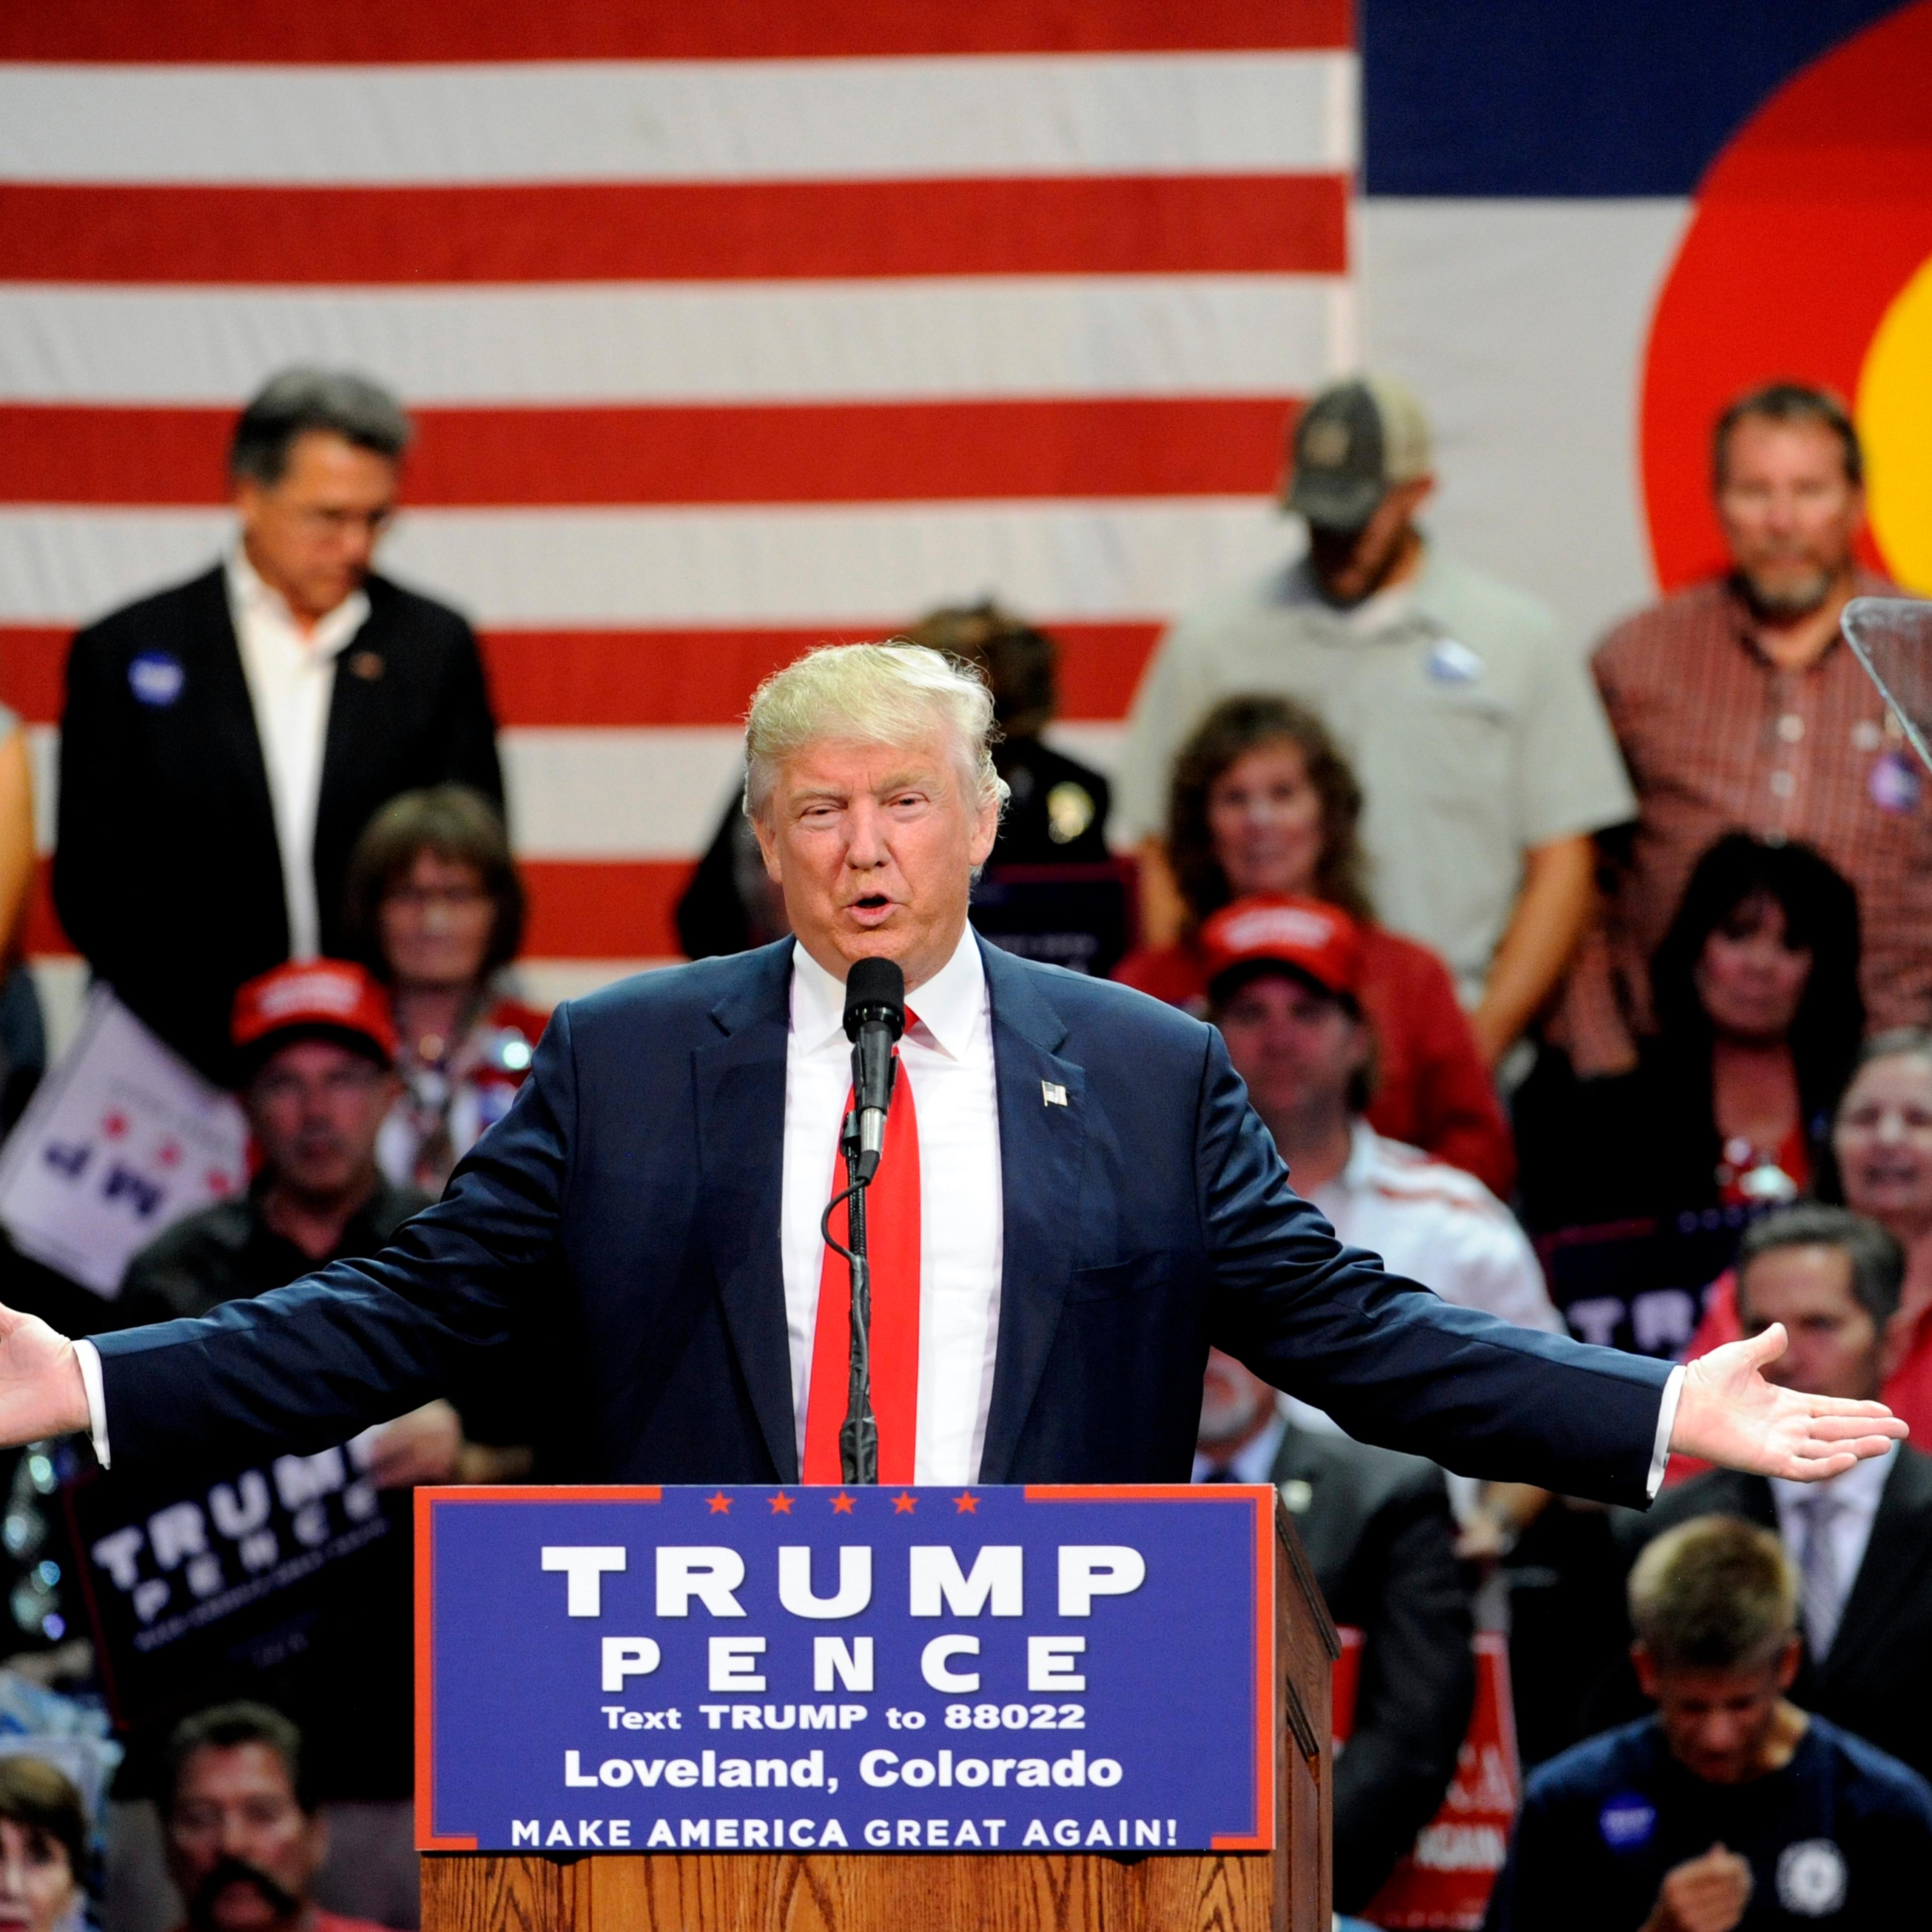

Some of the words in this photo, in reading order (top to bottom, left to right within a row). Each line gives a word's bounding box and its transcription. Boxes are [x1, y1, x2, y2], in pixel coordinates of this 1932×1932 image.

[541, 1546, 1145, 1619] TRUMP
[602, 1634, 1085, 1693] PENCE
[601, 1706, 681, 1729] Text
[699, 1705, 867, 1729] TRUMP
[886, 1708, 926, 1729] to
[944, 1704, 1085, 1729] 88022
[565, 1750, 838, 1794] Loveland,
[860, 1749, 1122, 1787] Colorado
[512, 1820, 630, 1846] MAKE
[647, 1819, 848, 1847] AMERICA
[864, 1819, 1006, 1846] GREAT
[1022, 1819, 1176, 1846] AGAIN!
